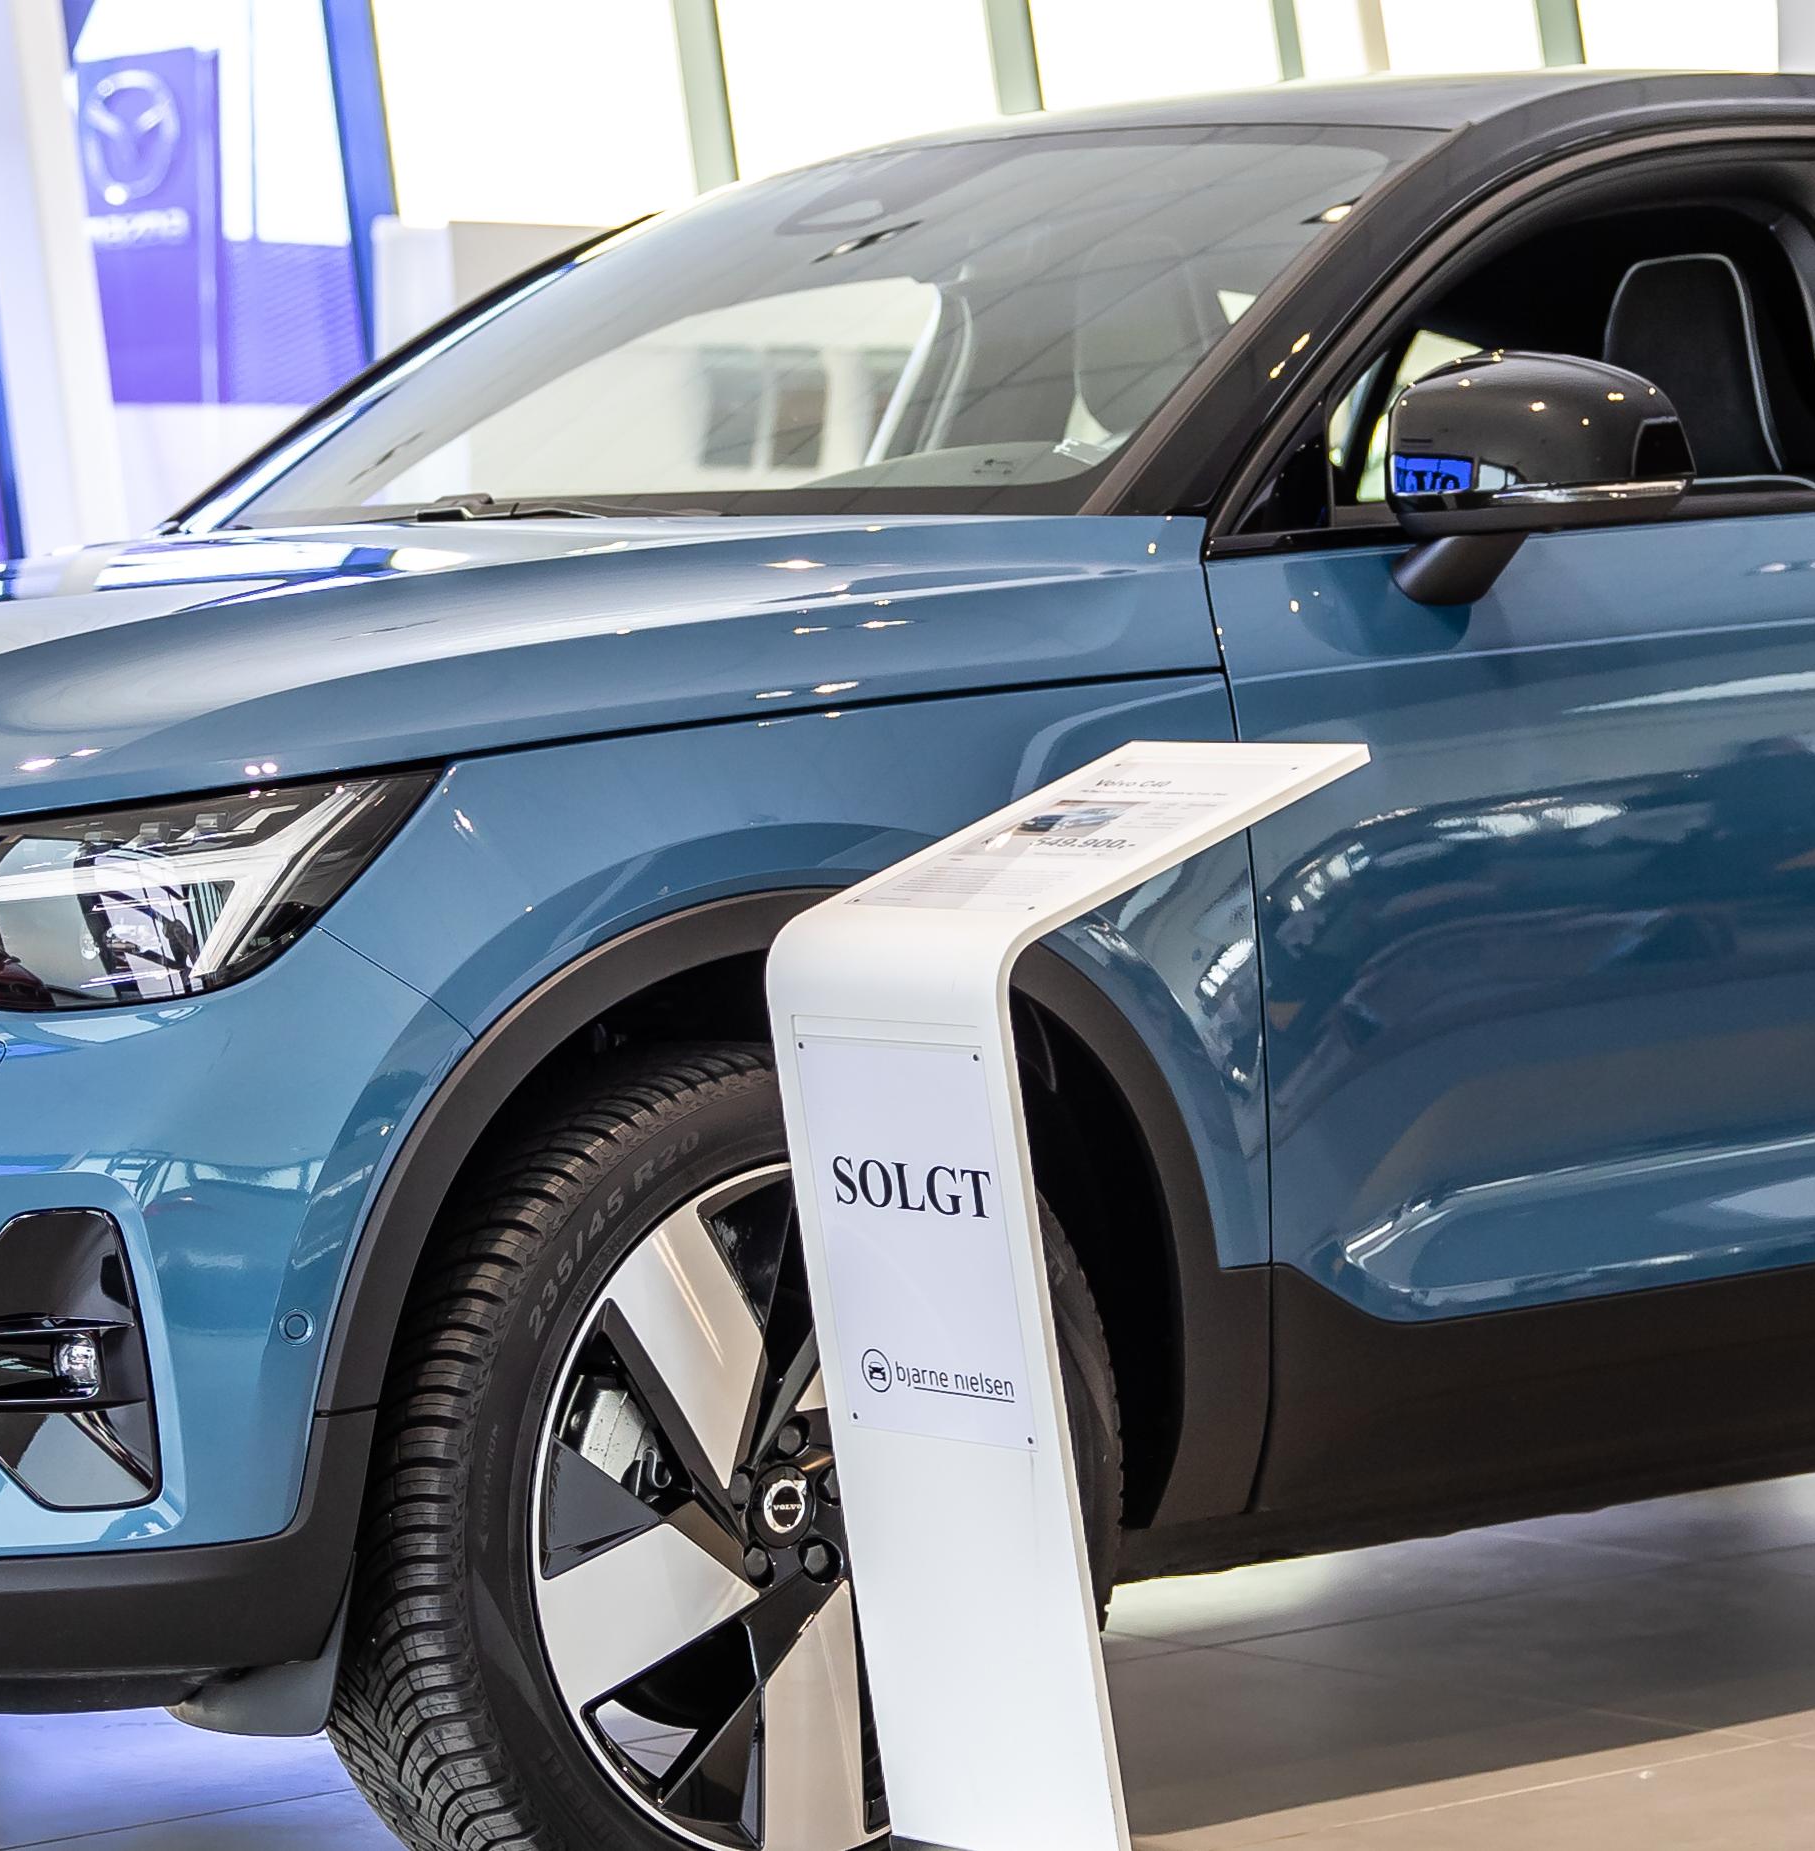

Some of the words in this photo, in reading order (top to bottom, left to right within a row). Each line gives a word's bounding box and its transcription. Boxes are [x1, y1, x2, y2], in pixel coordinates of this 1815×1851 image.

[1095, 778, 1136, 788] Volvo
[1138, 779, 1172, 788] C40
[832, 1155, 991, 1219] SOLGT
[529, 1186, 624, 1341] 235/45
[633, 1131, 699, 1192] R20
[895, 1360, 949, 1388] bjarne
[954, 1372, 1015, 1397] nielsen
[772, 1503, 802, 1511] VOLVO
